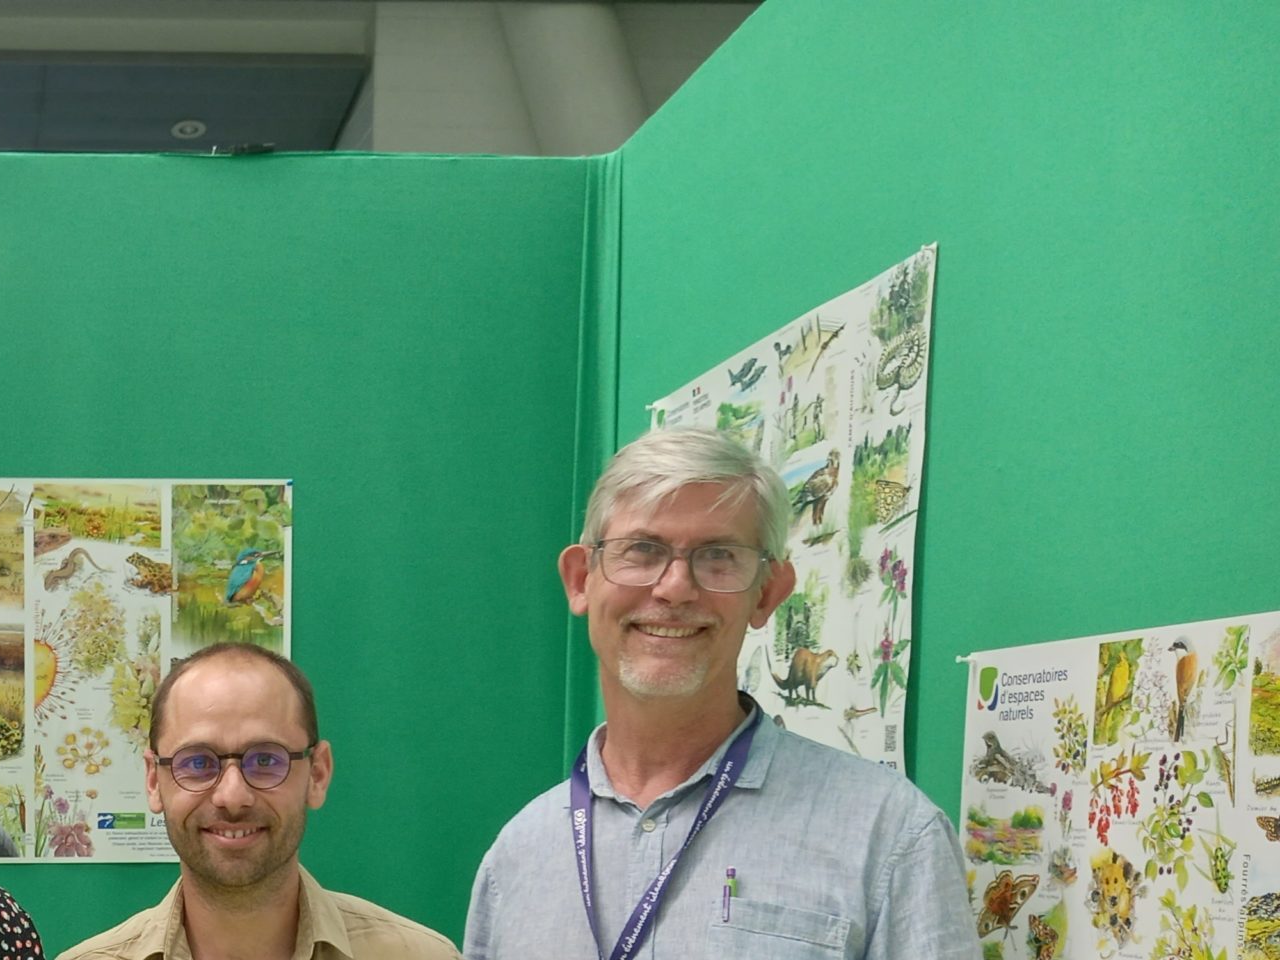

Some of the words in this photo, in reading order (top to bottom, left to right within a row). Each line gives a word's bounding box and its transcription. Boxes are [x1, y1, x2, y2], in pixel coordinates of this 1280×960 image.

[1001, 667, 1068, 687] Conservatoires
[1000, 690, 1045, 705] d'espaces
[999, 706, 1034, 721] naturels
